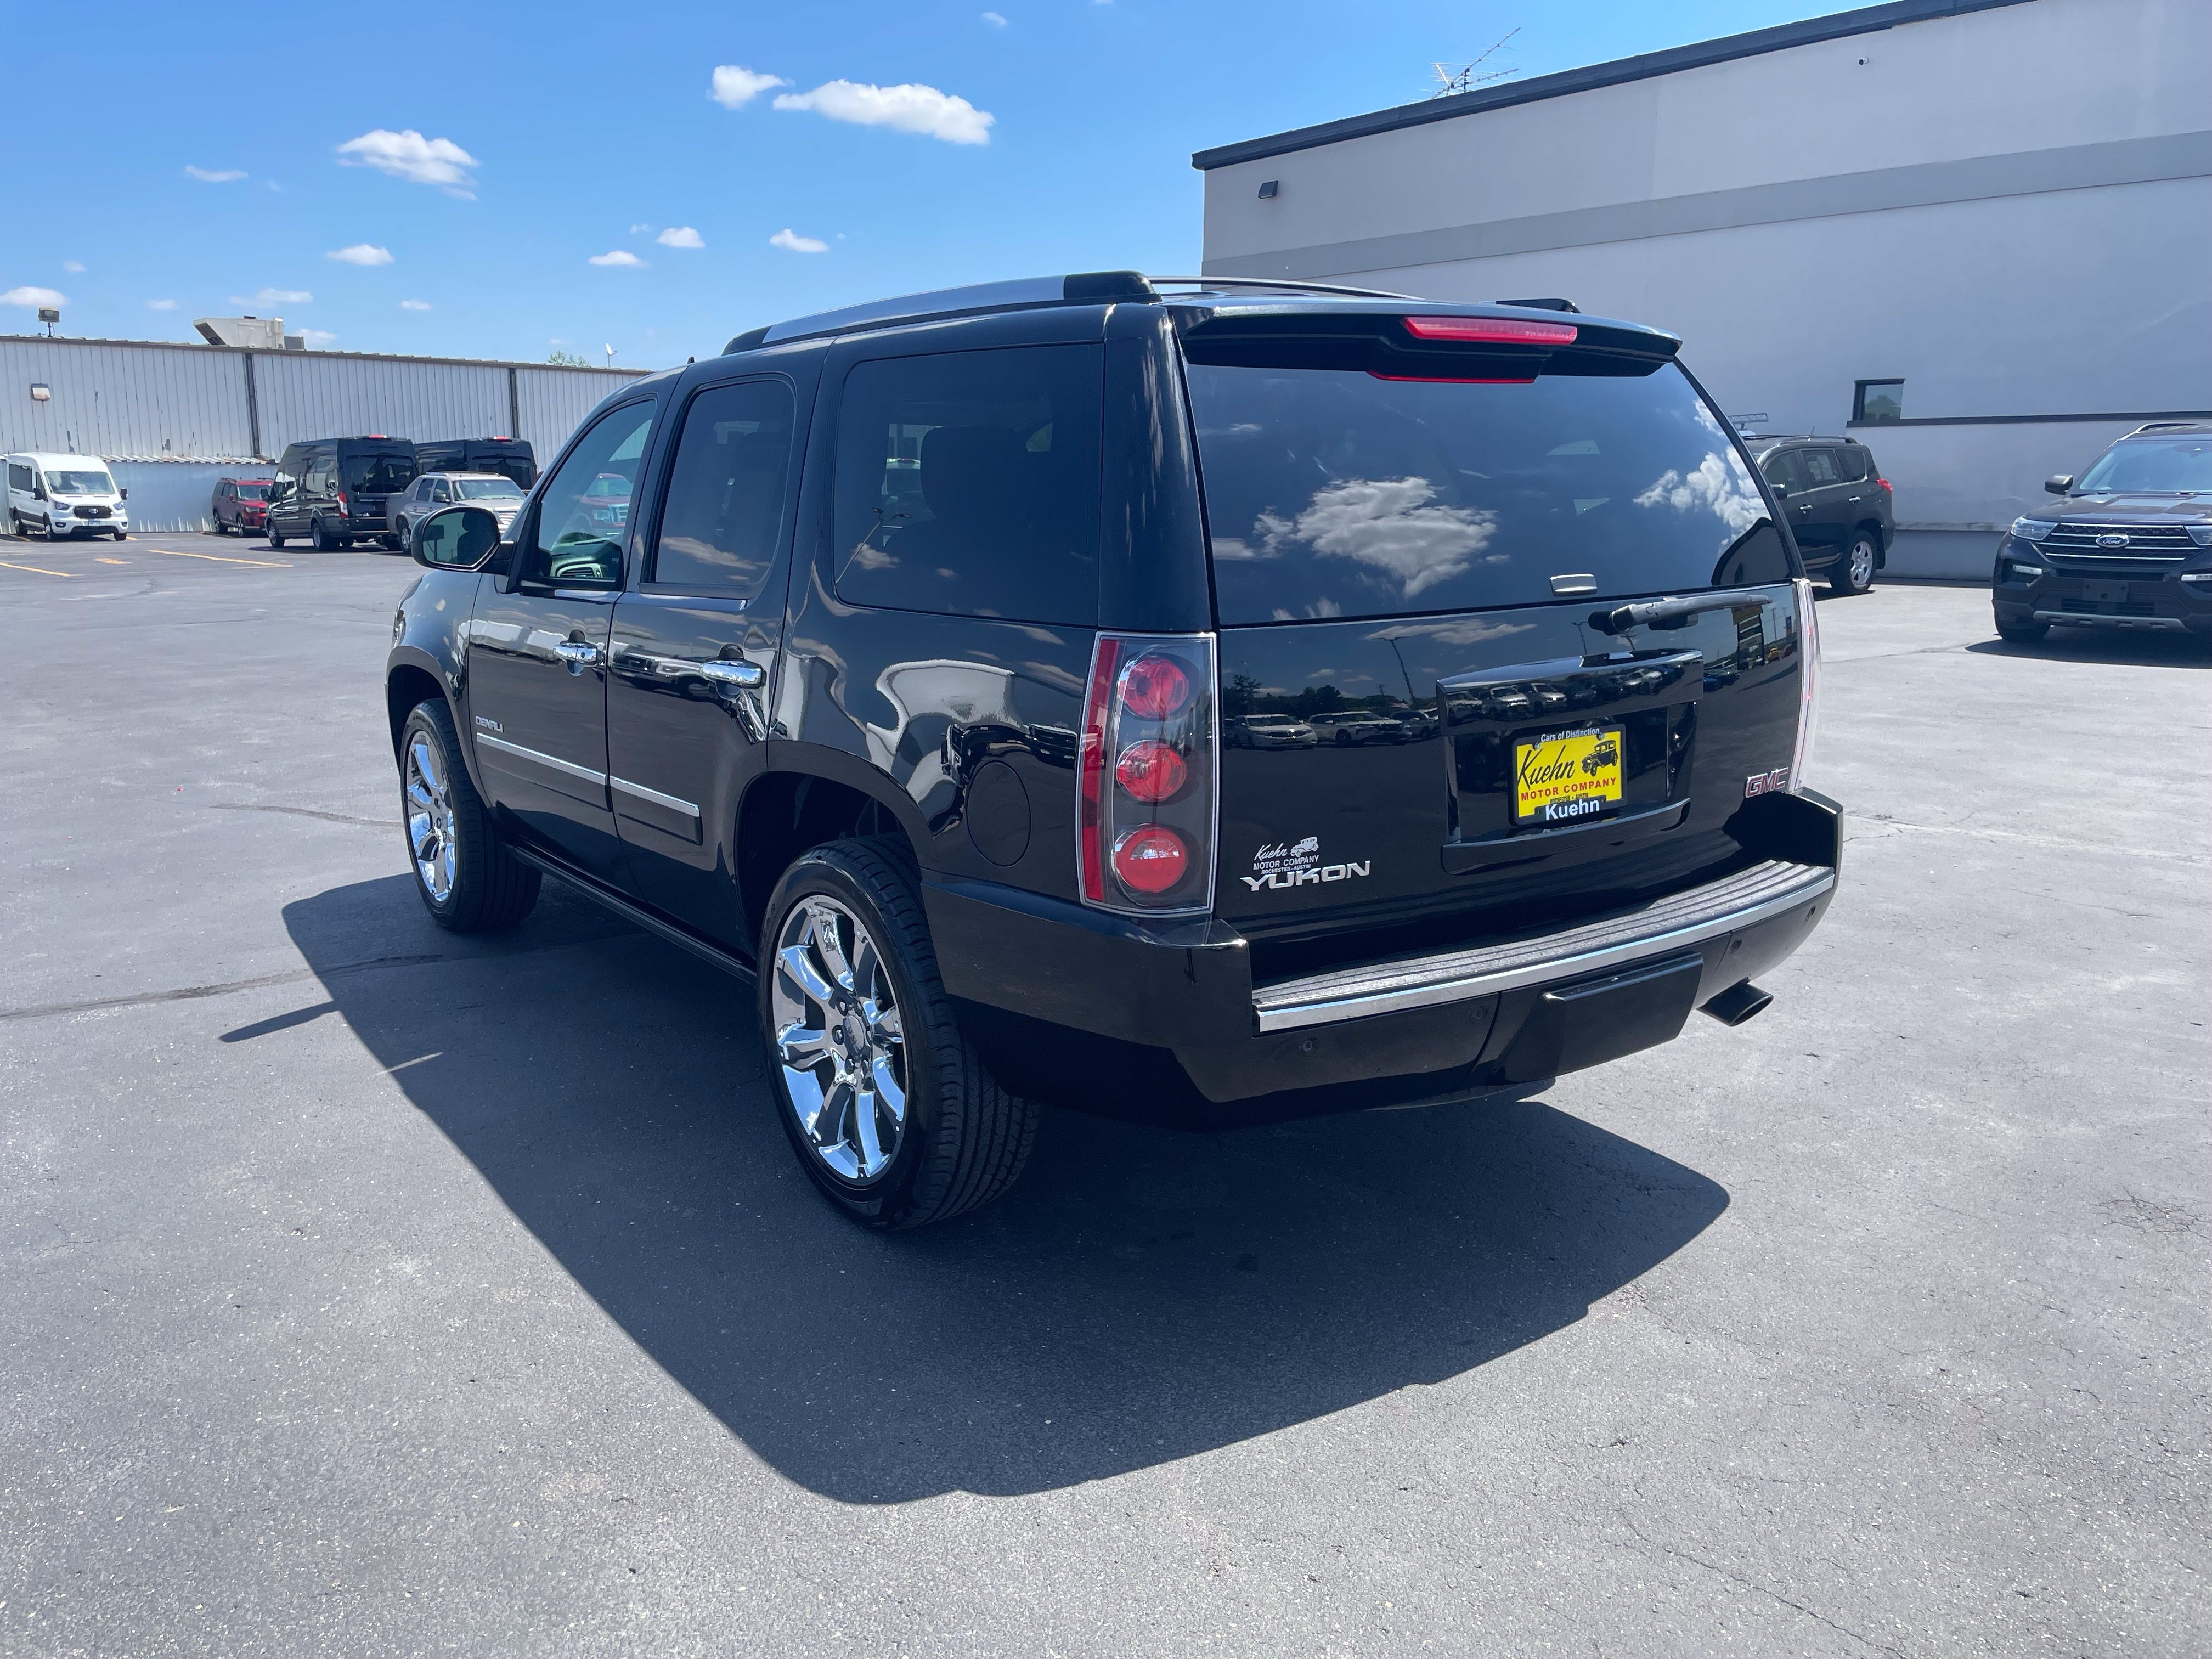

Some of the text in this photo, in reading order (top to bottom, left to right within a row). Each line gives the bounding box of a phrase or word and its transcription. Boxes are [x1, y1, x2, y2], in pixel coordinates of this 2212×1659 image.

[475, 715, 504, 733] DENALI
[1541, 727, 1600, 742] Cars of Distinction
[1517, 745, 1576, 790] Kuehn
[1521, 777, 1616, 801] MOTOR COMPANY
[1745, 767, 1788, 798] GMC
[1545, 799, 1600, 821] Kuehn
[1254, 842, 1288, 861] Kuehn
[1253, 855, 1319, 871] MOTOR COMPANY
[1239, 860, 1370, 891] YUKON
